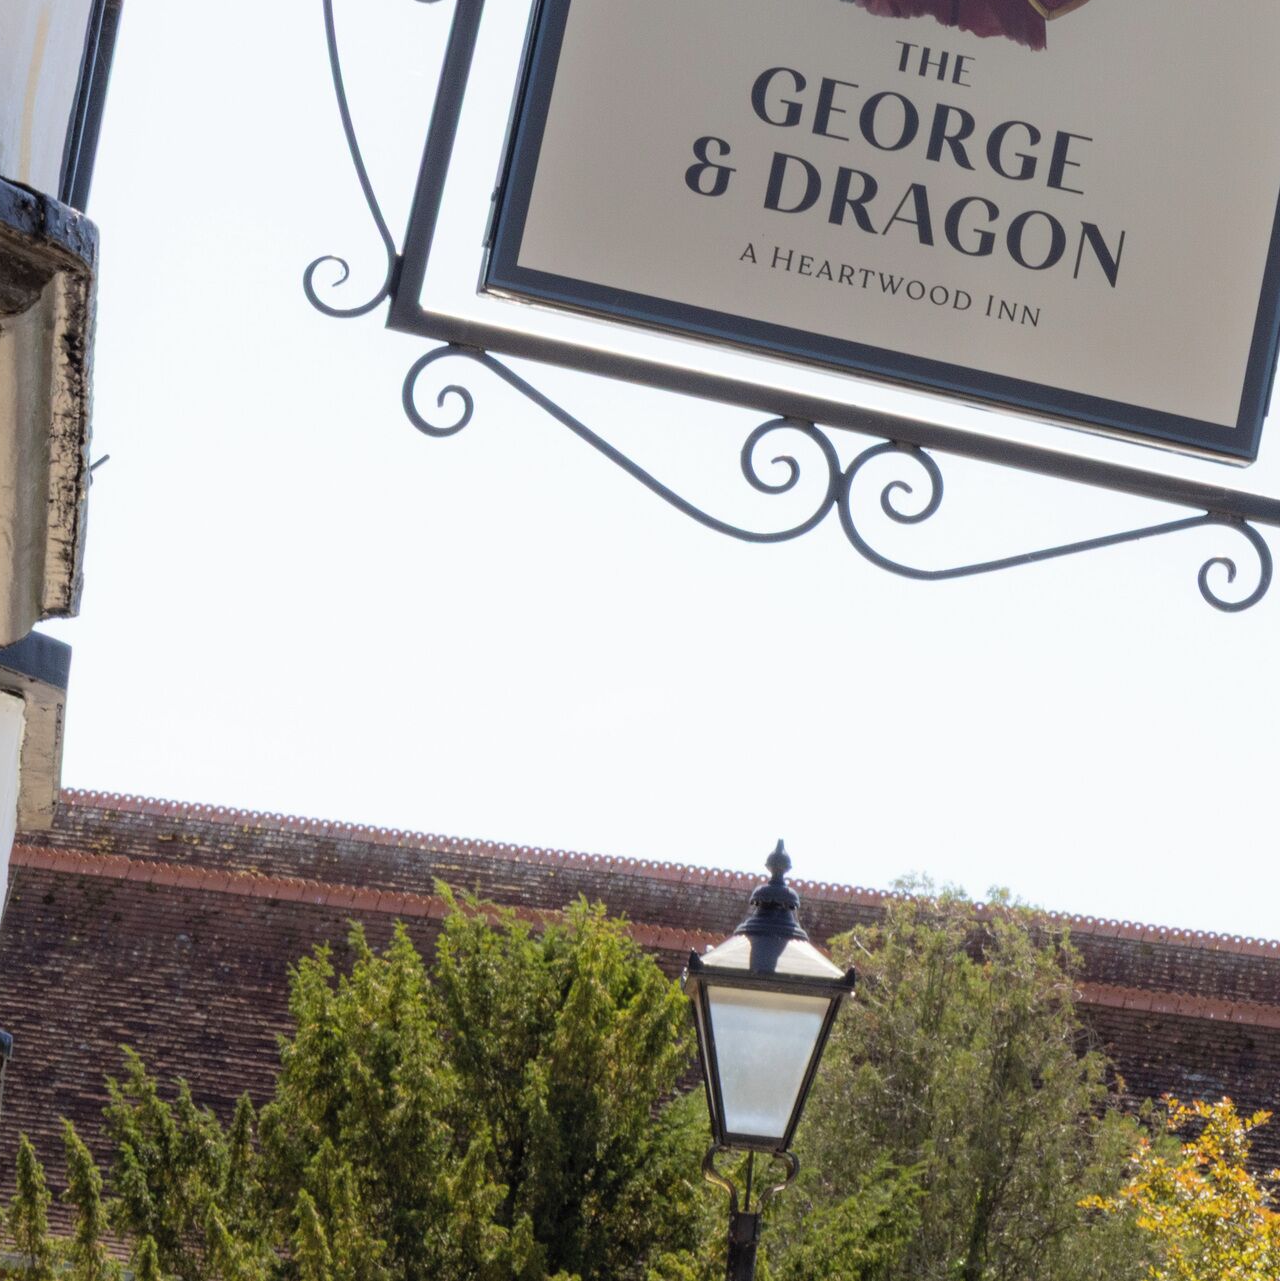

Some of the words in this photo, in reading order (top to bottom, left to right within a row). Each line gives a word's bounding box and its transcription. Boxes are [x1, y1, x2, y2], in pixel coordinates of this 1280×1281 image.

[895, 40, 976, 87] THE
[750, 66, 1094, 195] GEORGE
[684, 135, 737, 197] &
[763, 151, 1126, 289] DRAGON
[739, 242, 757, 264] A
[770, 246, 972, 311] HEARTWOOD
[985, 294, 1041, 328] INN
